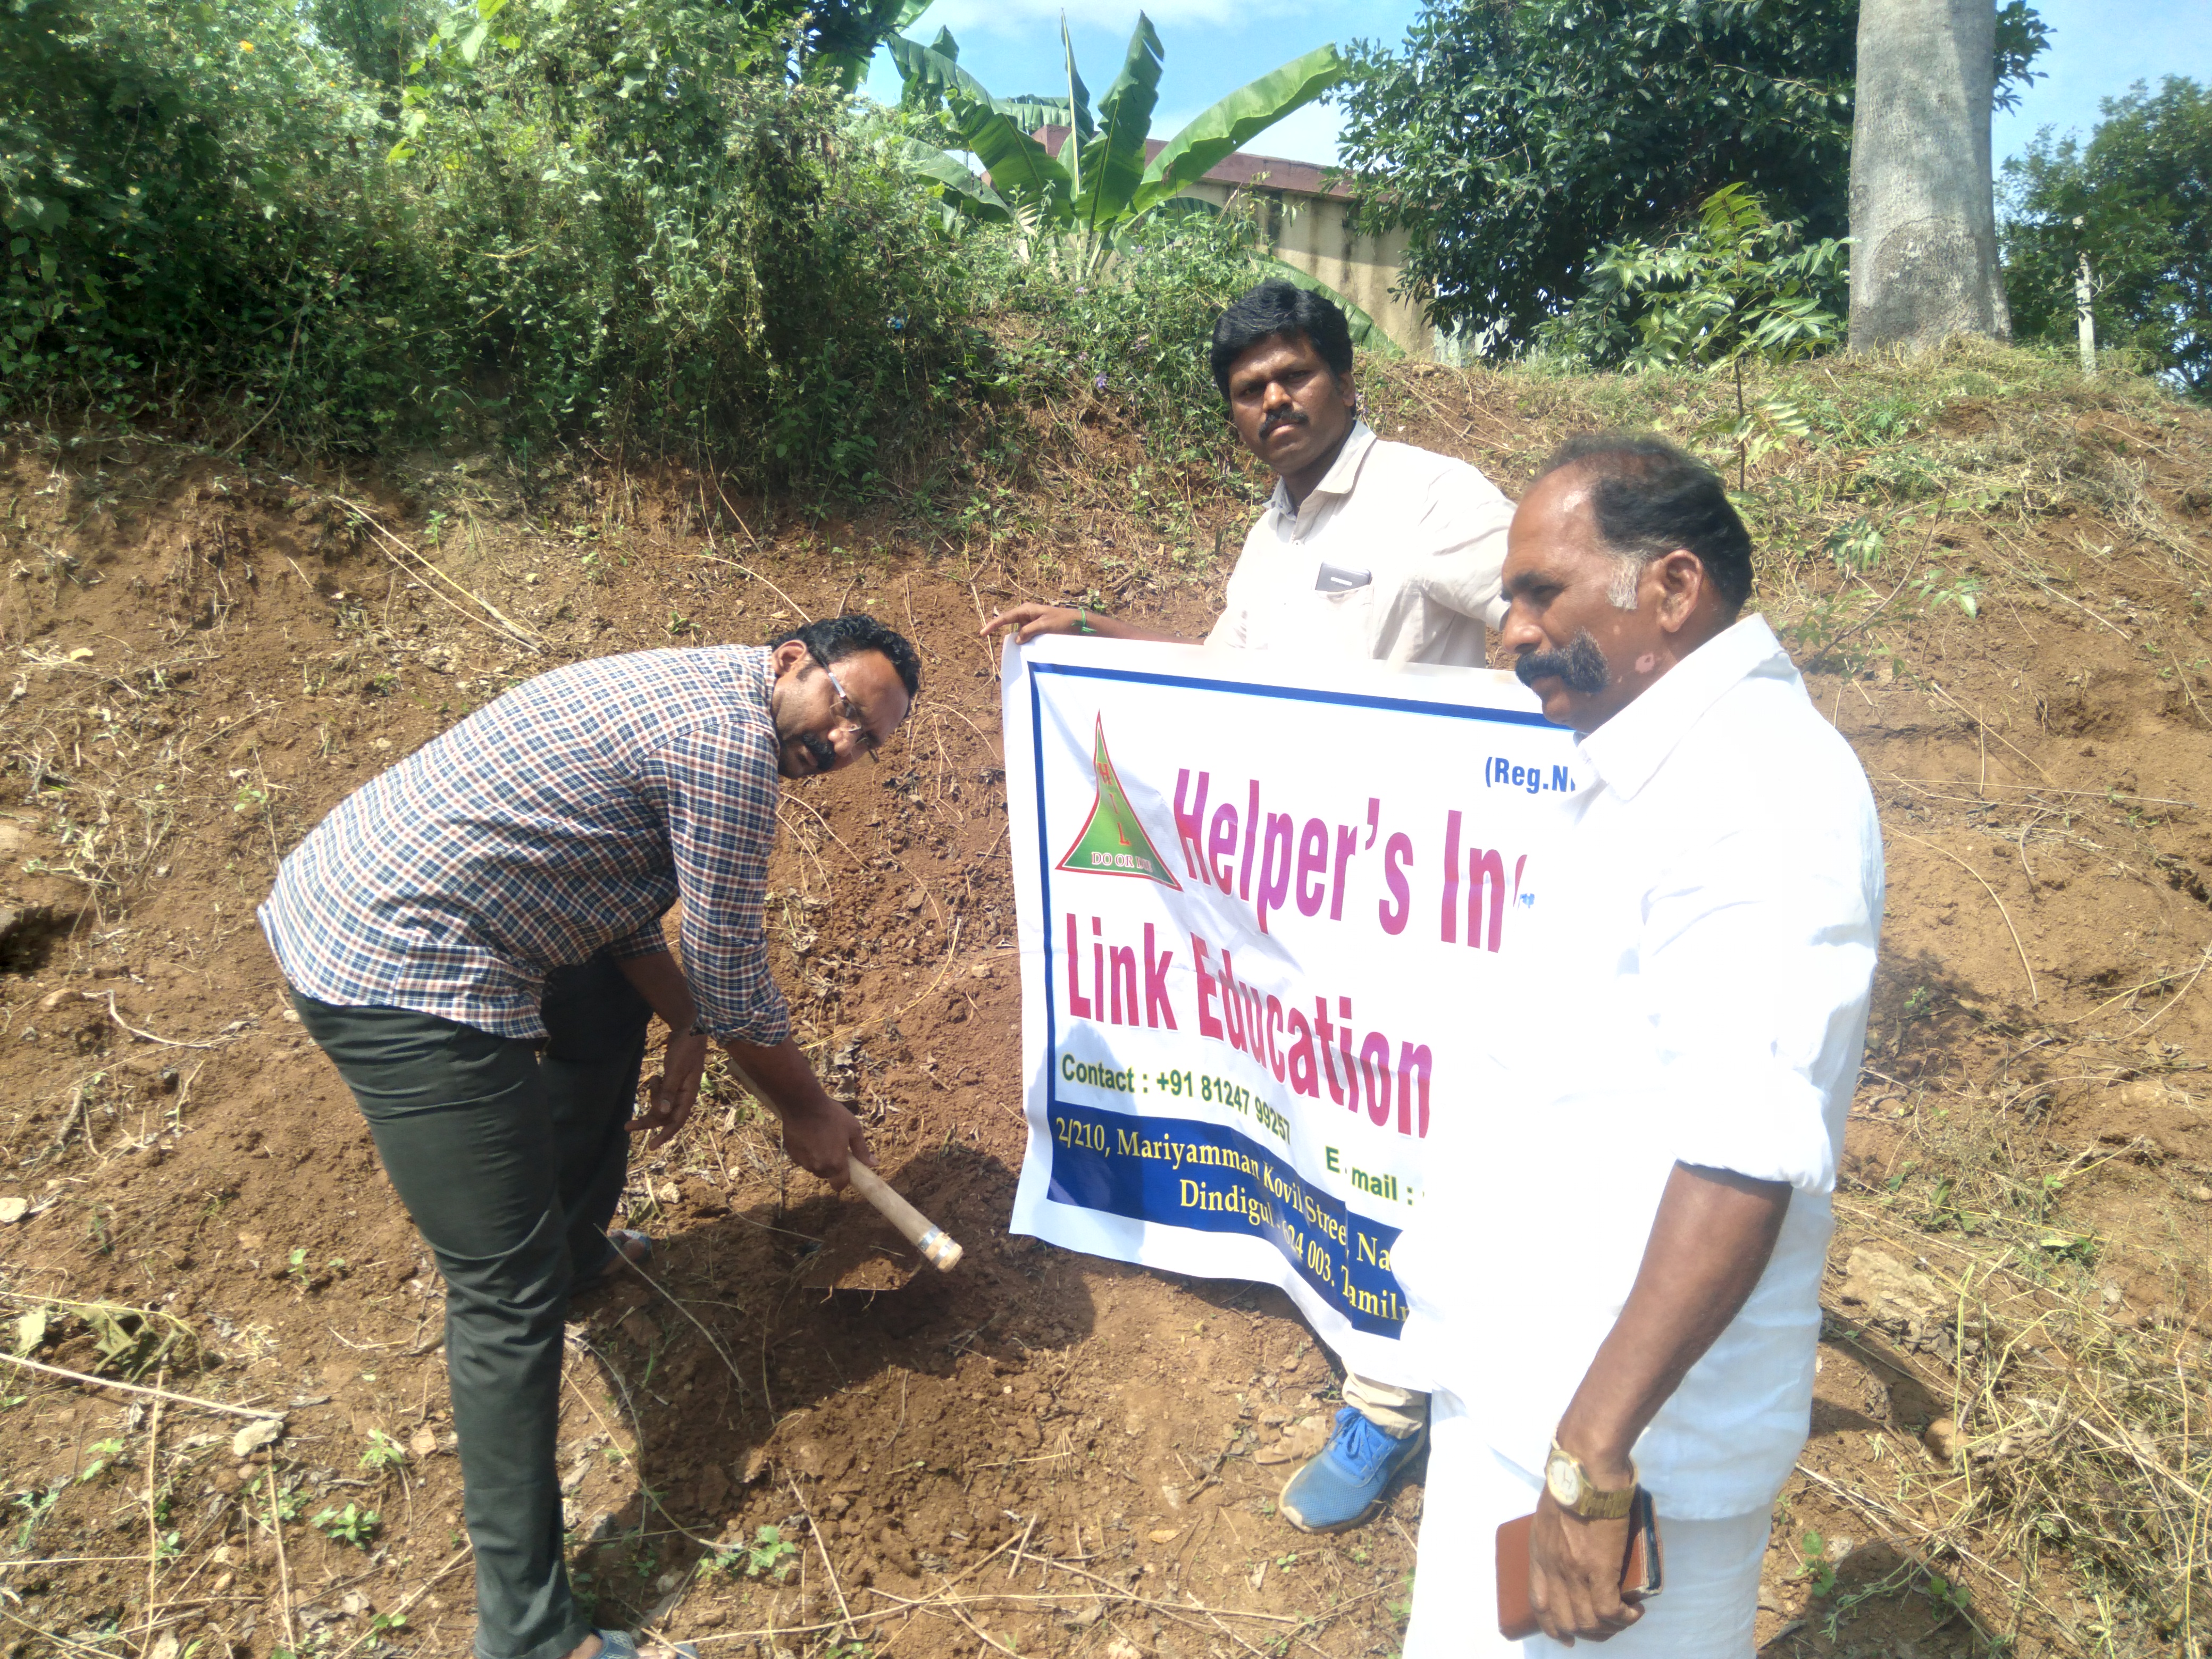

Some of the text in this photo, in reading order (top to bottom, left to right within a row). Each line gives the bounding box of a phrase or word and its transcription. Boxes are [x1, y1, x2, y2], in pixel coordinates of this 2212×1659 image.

[1485, 756, 1576, 794] (Reg.N
[1092, 852, 1112, 865] DO
[1116, 854, 1134, 867] OR
[1173, 768, 1528, 953] Helper's In
[1066, 912, 1433, 1139] Link Education
[1055, 1117, 1111, 1158] 2/210,
[1117, 1128, 1260, 1181] Mariyamman
[1263, 1161, 1304, 1214] Kovil
[1304, 1195, 1350, 1259] Stree,
[1062, 1053, 1135, 1093] Contact
[1142, 1074, 1149, 1093] :
[1156, 1069, 1194, 1097] +91
[1201, 1075, 1250, 1115] 81247
[1254, 1096, 1292, 1146] 99257
[1407, 1186, 1413, 1206] :
[1179, 1178, 1275, 1228] Dindigul
[1282, 1220, 1304, 1262] 624
[1307, 1240, 1335, 1287] 003.
